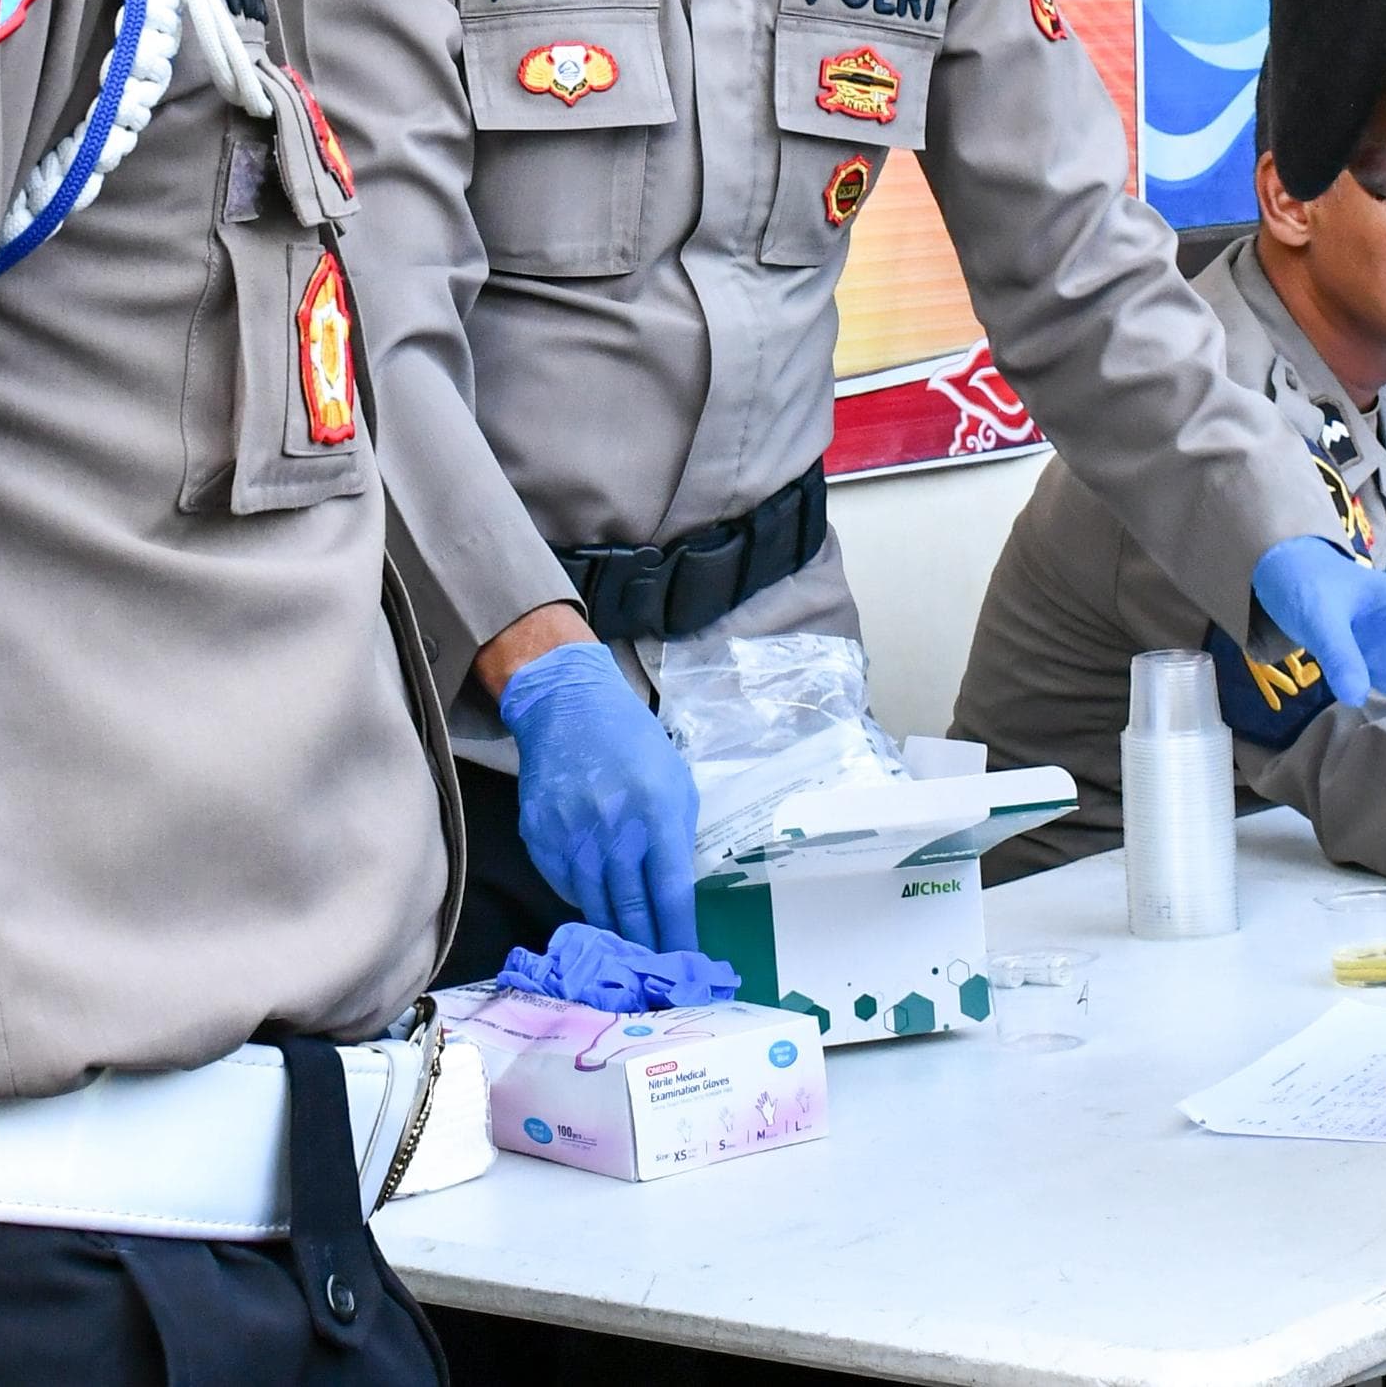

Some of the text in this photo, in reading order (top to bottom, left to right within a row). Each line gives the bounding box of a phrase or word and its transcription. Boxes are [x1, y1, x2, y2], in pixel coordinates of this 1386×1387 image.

[648, 1068, 707, 1091] Nitrile Medical
[650, 1084, 701, 1103] Examination
[702, 1076, 730, 1090] Gloves
[673, 1149, 687, 1163] XS
[719, 1139, 726, 1151] S
[756, 1130, 766, 1142] M
[795, 1121, 802, 1132] L
